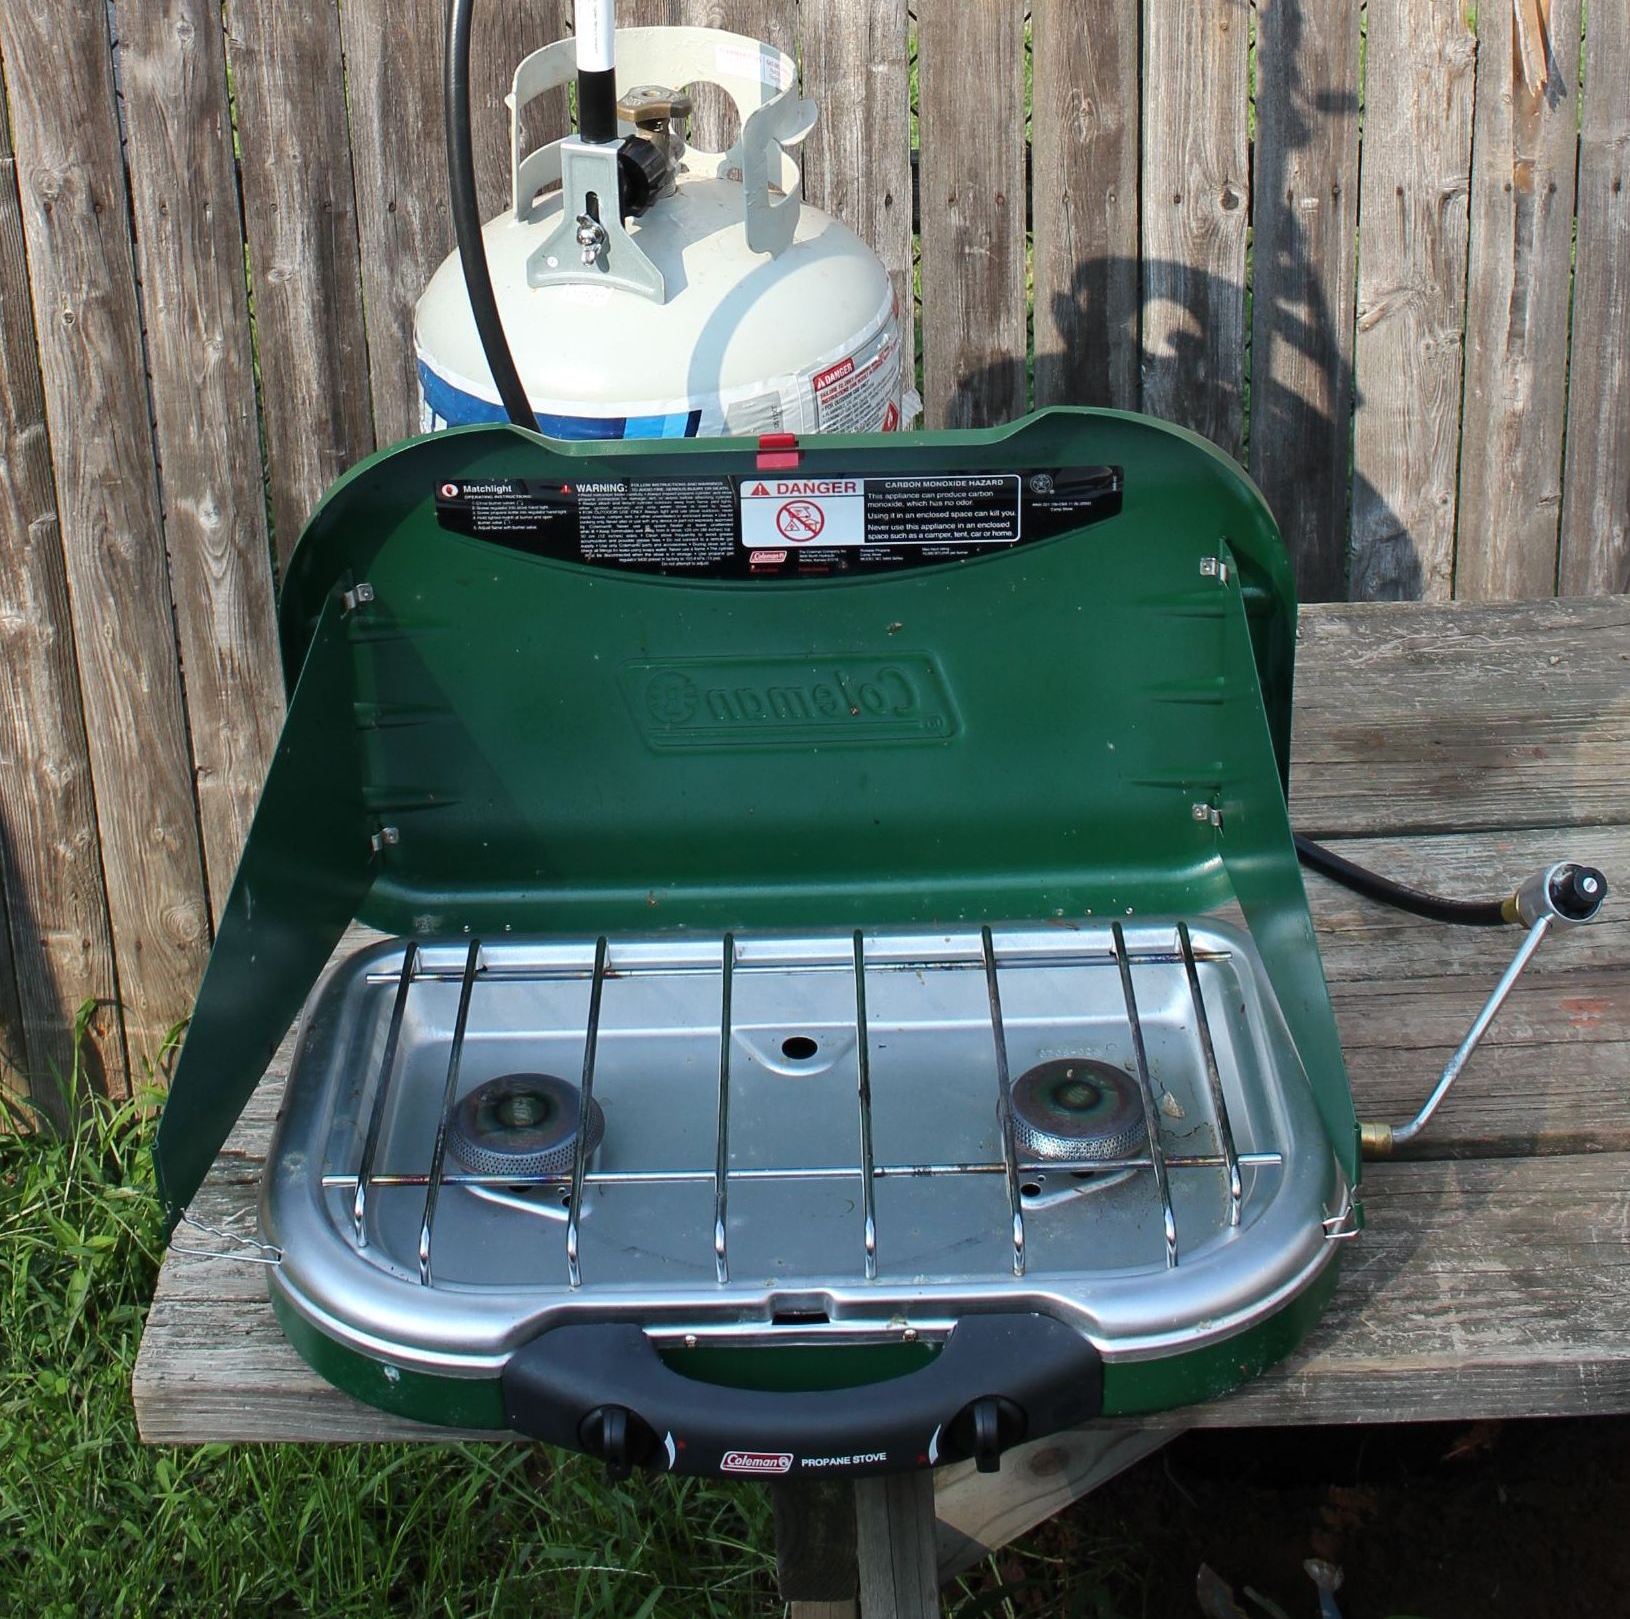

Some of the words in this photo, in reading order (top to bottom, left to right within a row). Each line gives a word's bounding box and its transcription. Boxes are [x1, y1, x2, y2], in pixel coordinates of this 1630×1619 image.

[824, 363, 852, 384] DANGER
[463, 485, 512, 494] Matchlight
[576, 484, 628, 492] WARNING:
[777, 481, 857, 495] DANGER
[727, 1454, 778, 1467] Coleman
[801, 1456, 851, 1468] PROPANE
[852, 1452, 887, 1464] STOVE
